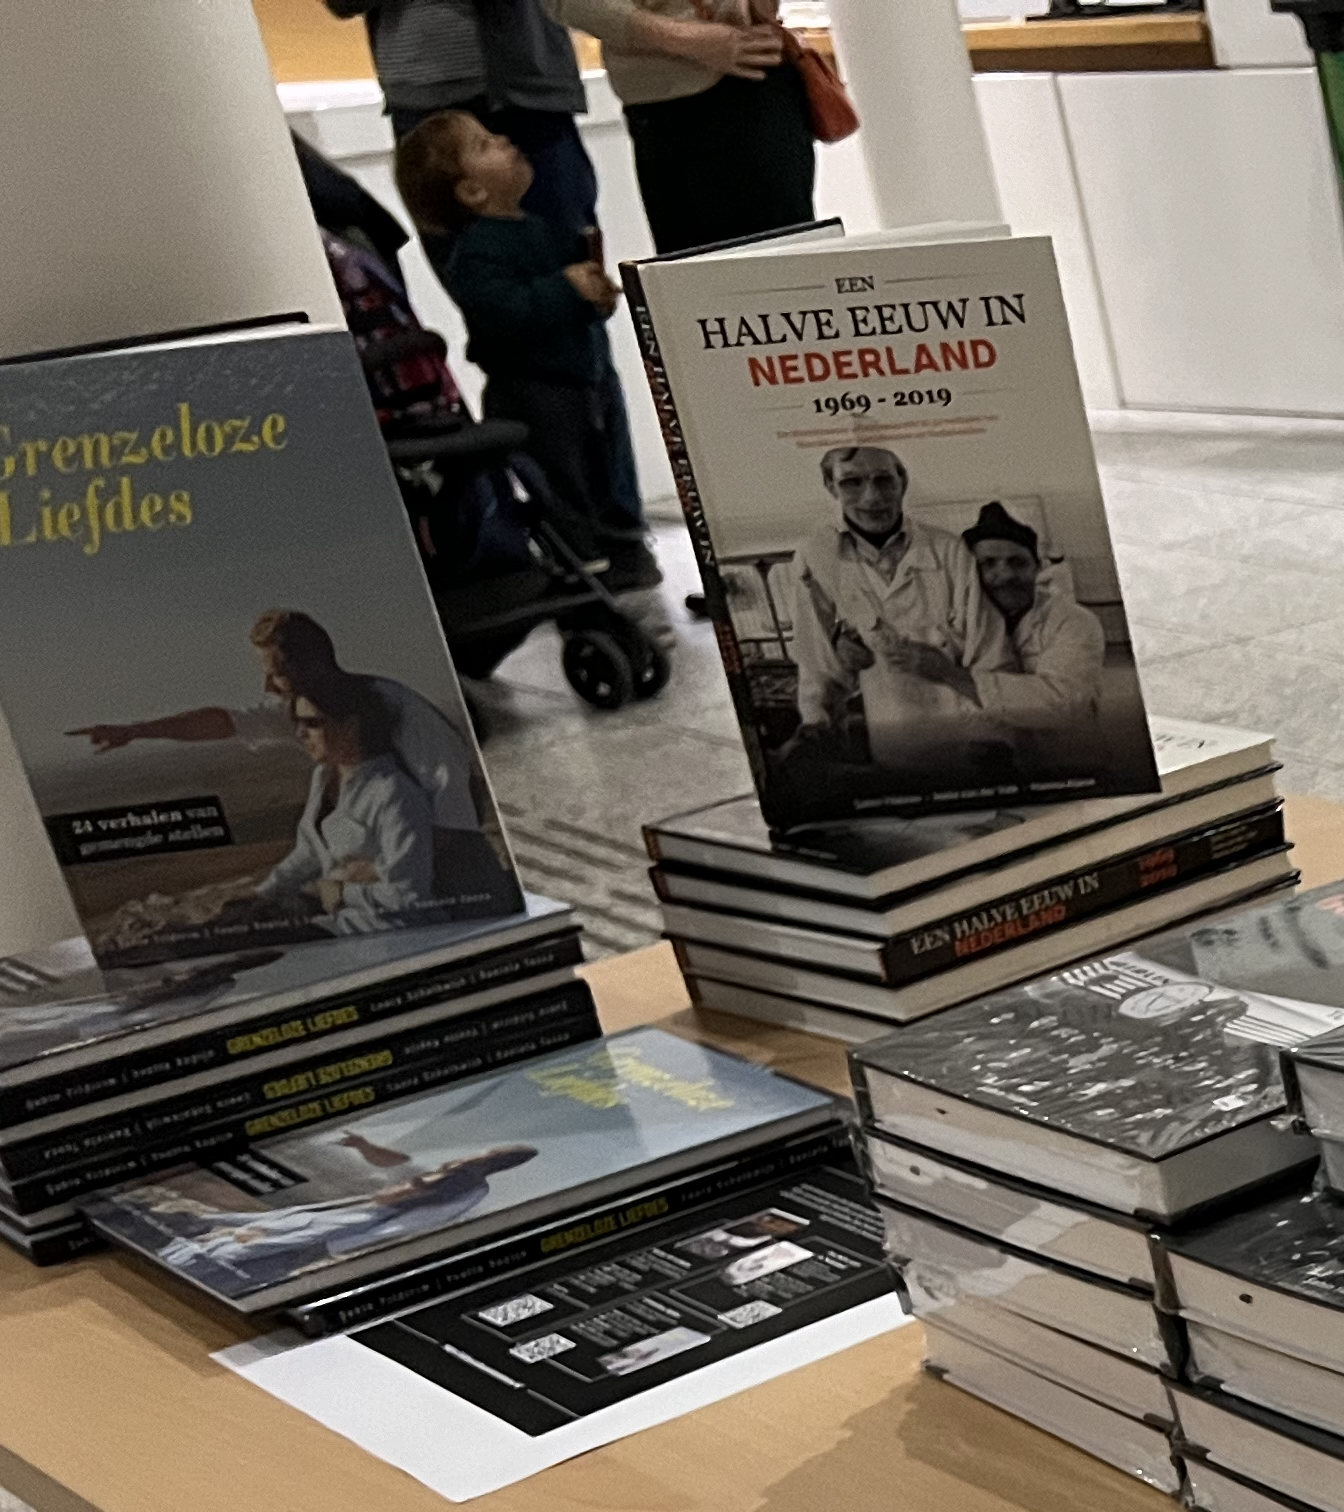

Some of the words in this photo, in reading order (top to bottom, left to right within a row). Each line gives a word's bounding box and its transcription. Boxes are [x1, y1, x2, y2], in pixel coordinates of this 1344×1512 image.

[835, 275, 875, 295] EEN
[697, 307, 840, 350] HALVE
[850, 299, 971, 340] EEUW
[980, 293, 1028, 328] IN
[748, 338, 998, 388] NEDERLAND
[812, 392, 872, 416] 1969
[894, 387, 953, 408] 2019
[951, 898, 1018, 942] HALVE
